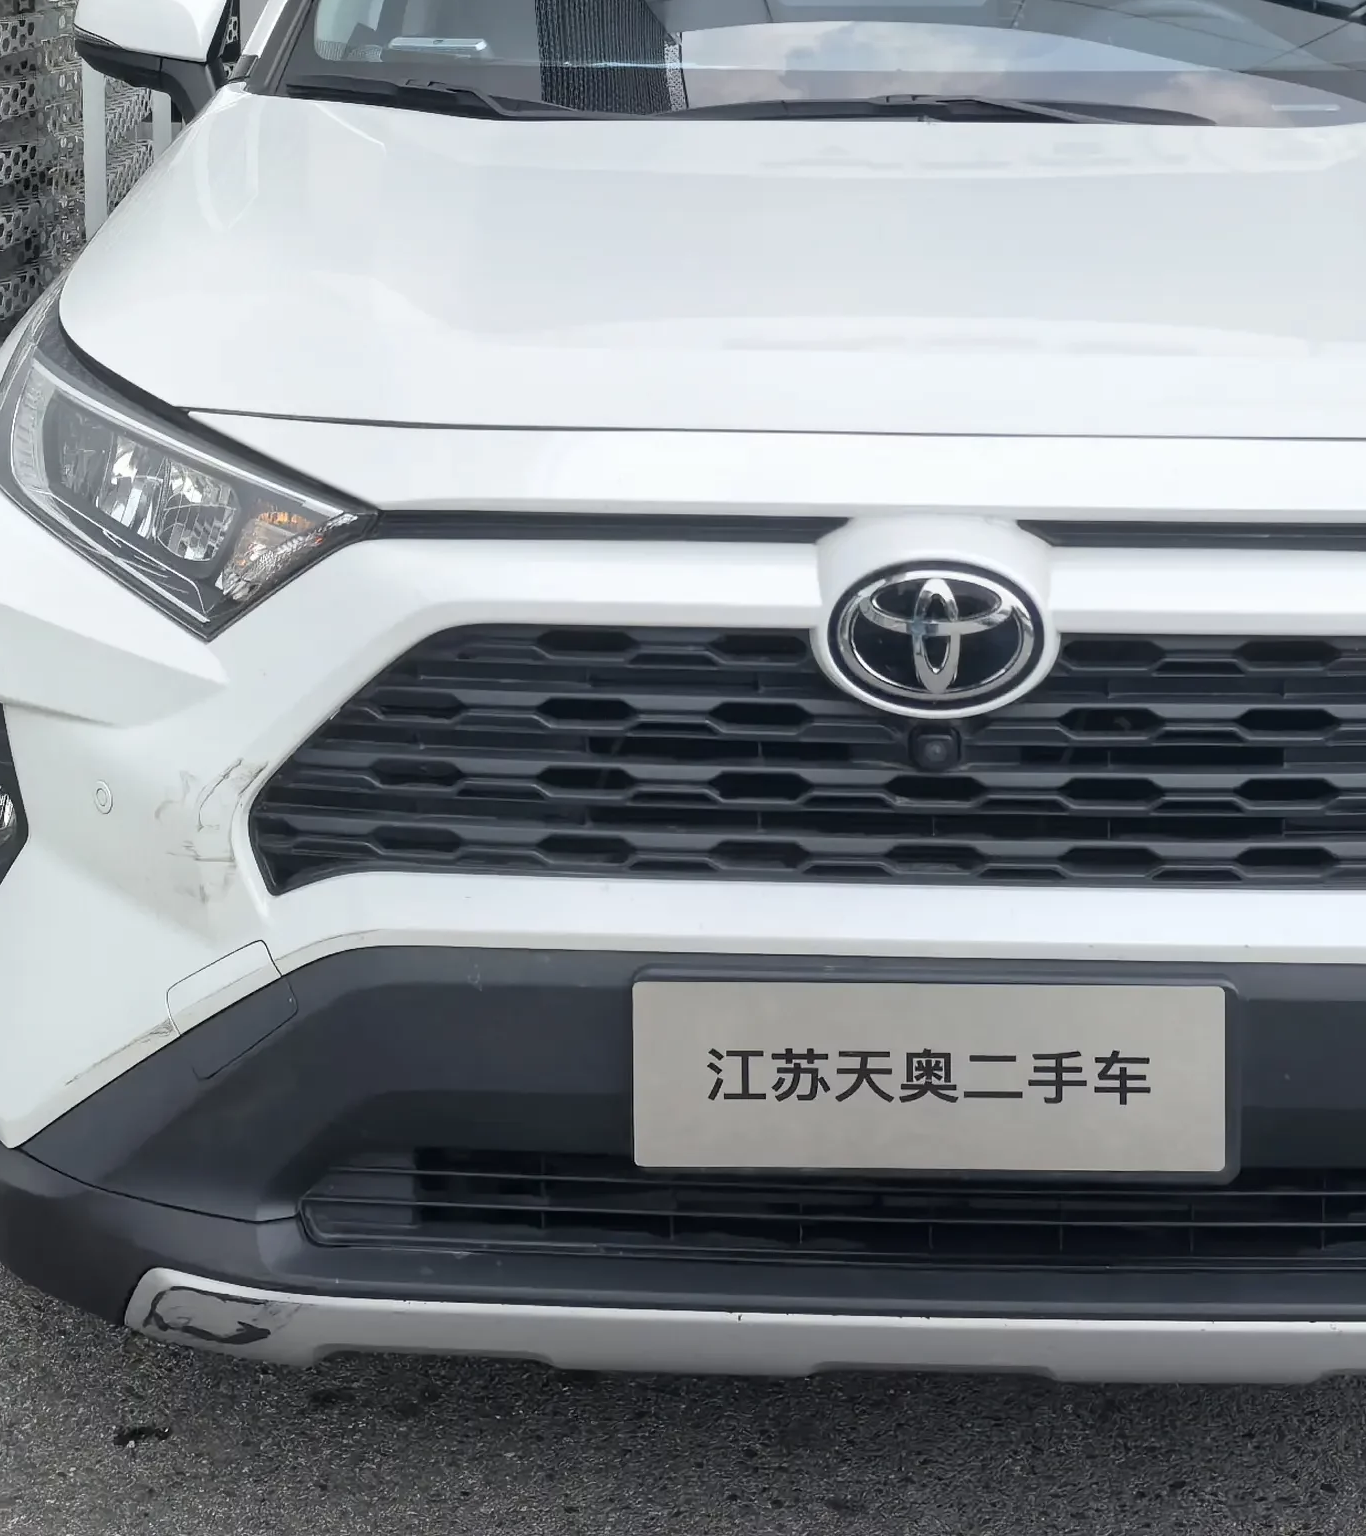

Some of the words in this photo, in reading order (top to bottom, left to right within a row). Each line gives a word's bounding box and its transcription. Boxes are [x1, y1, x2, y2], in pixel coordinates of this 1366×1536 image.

[705, 1046, 1152, 1106] 江苏天奥二手车
